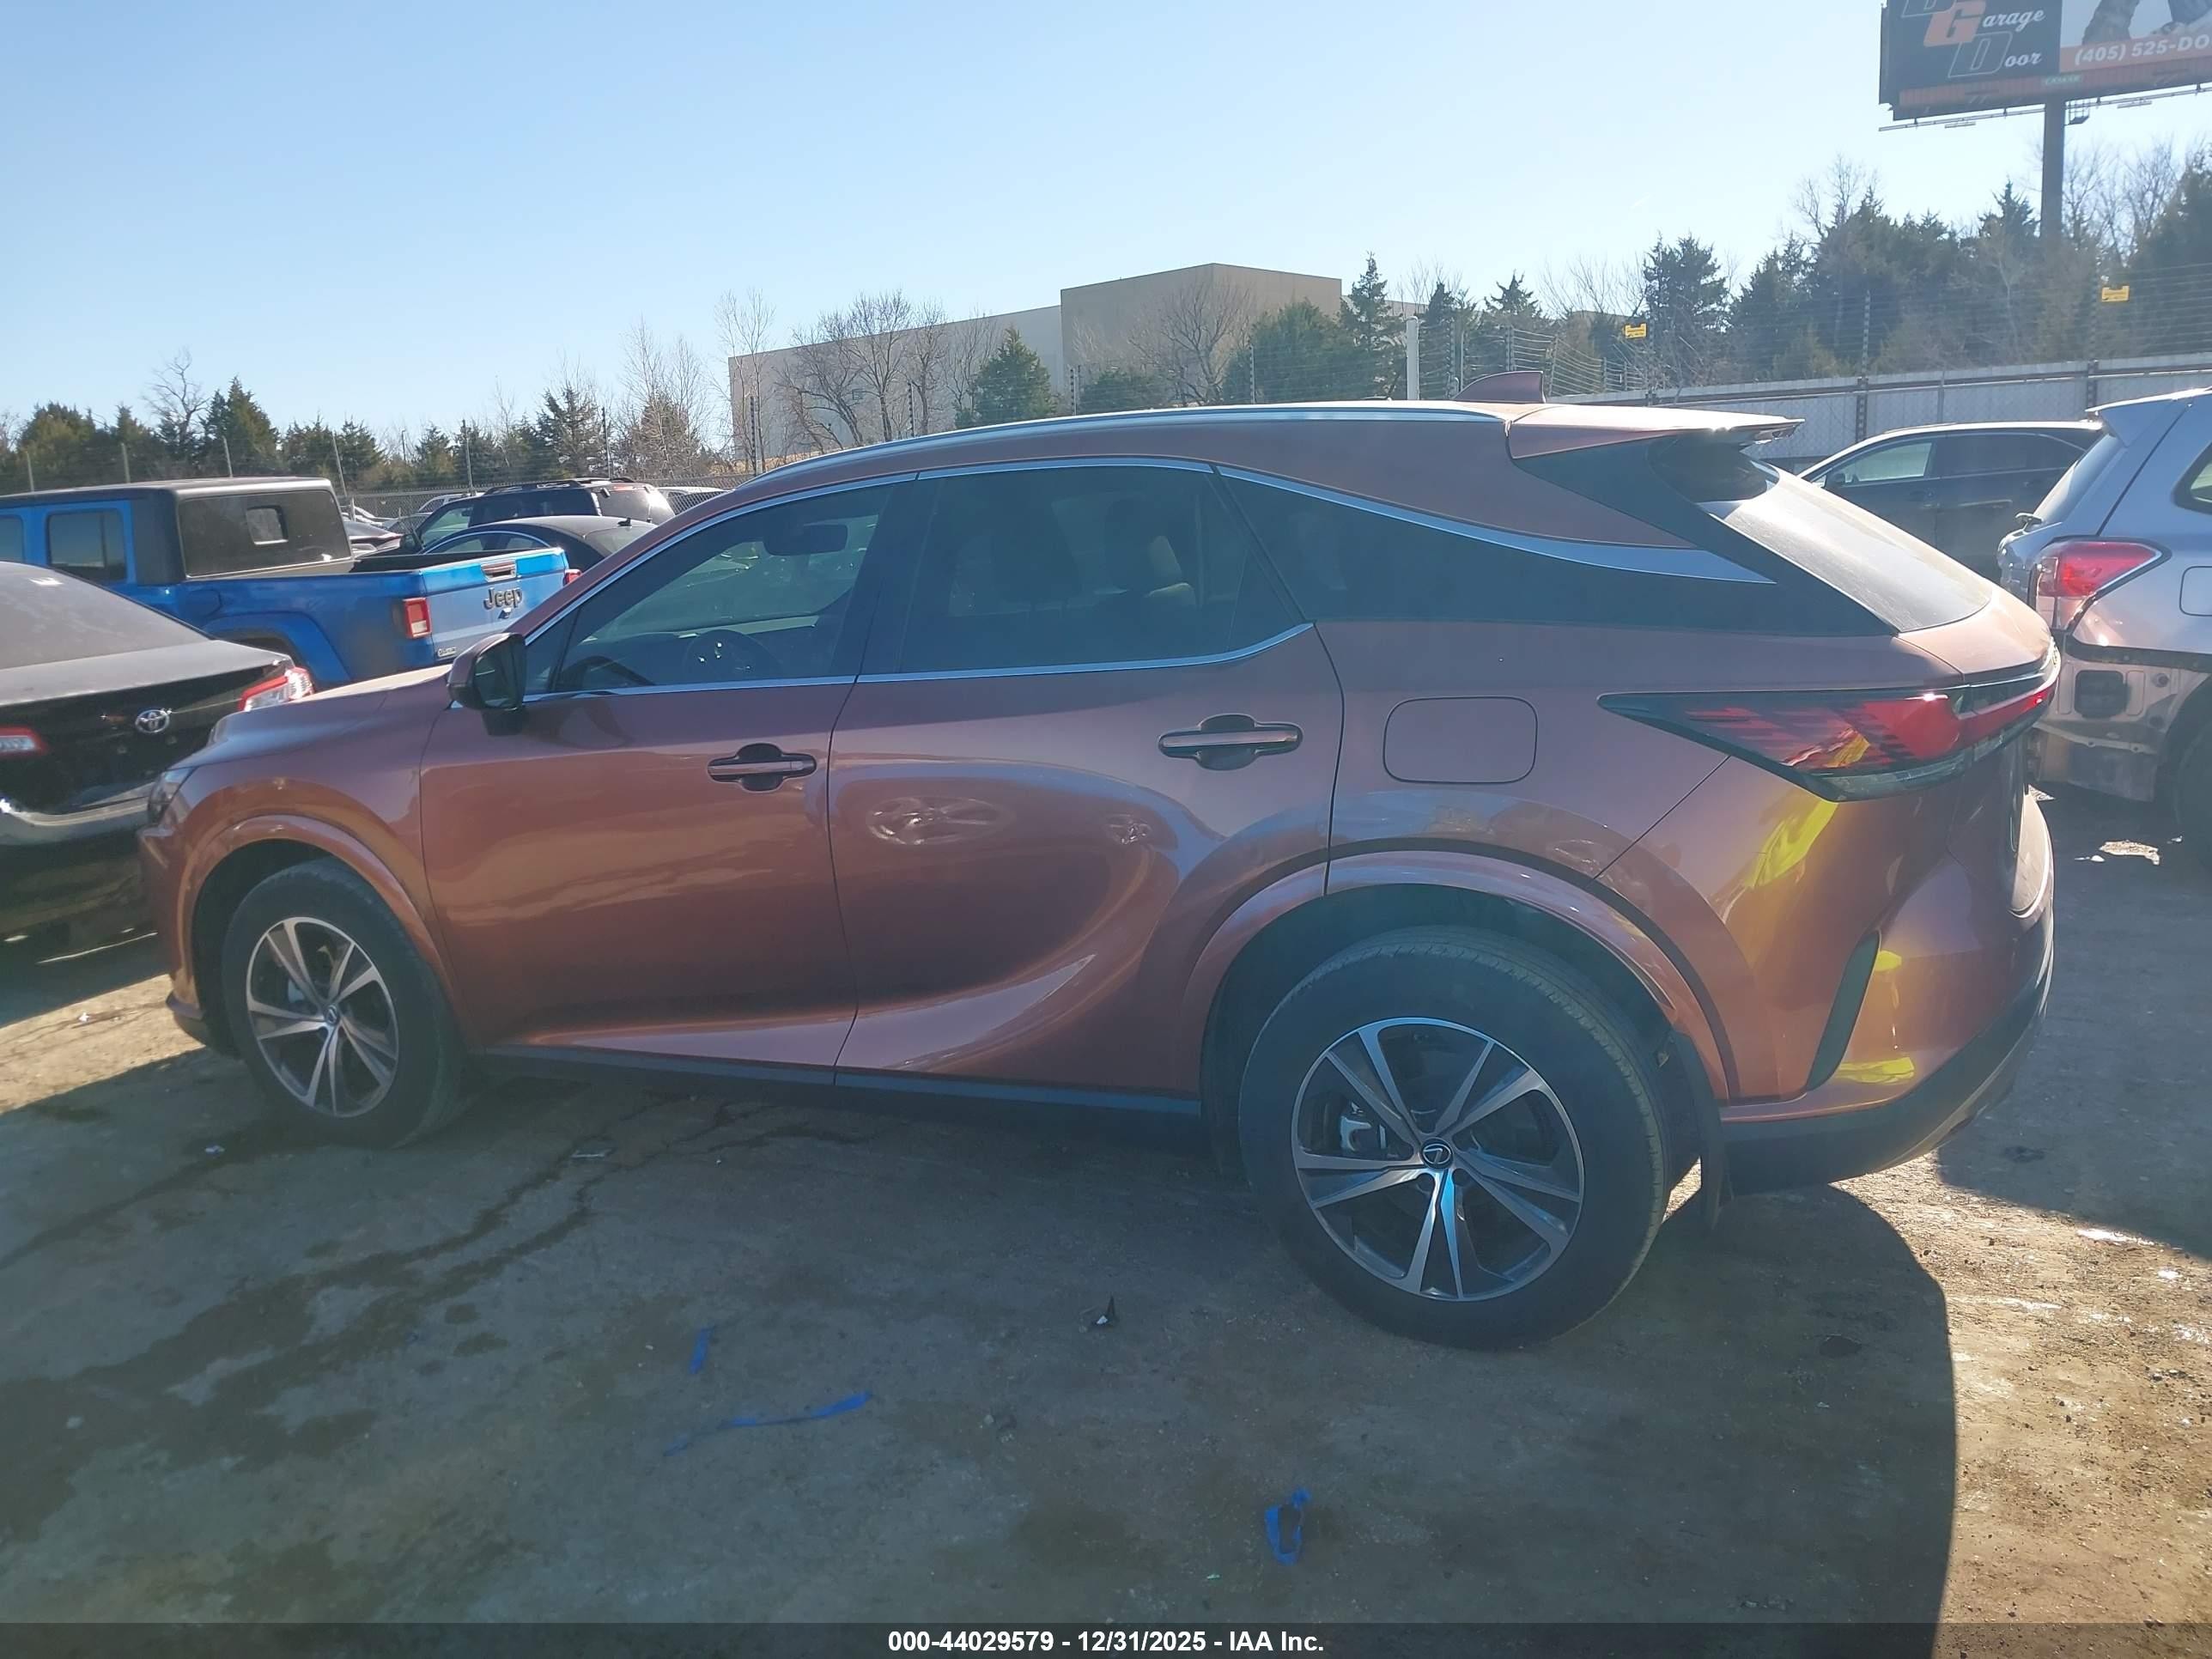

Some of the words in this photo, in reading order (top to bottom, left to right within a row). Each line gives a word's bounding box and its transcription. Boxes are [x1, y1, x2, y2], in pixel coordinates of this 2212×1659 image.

[1923, 0, 2045, 47] Garage
[1948, 31, 2042, 78] Door
[2075, 44, 2127, 66] (405)
[2131, 33, 2212, 57] 525-DO
[483, 586, 523, 611] Jeep
